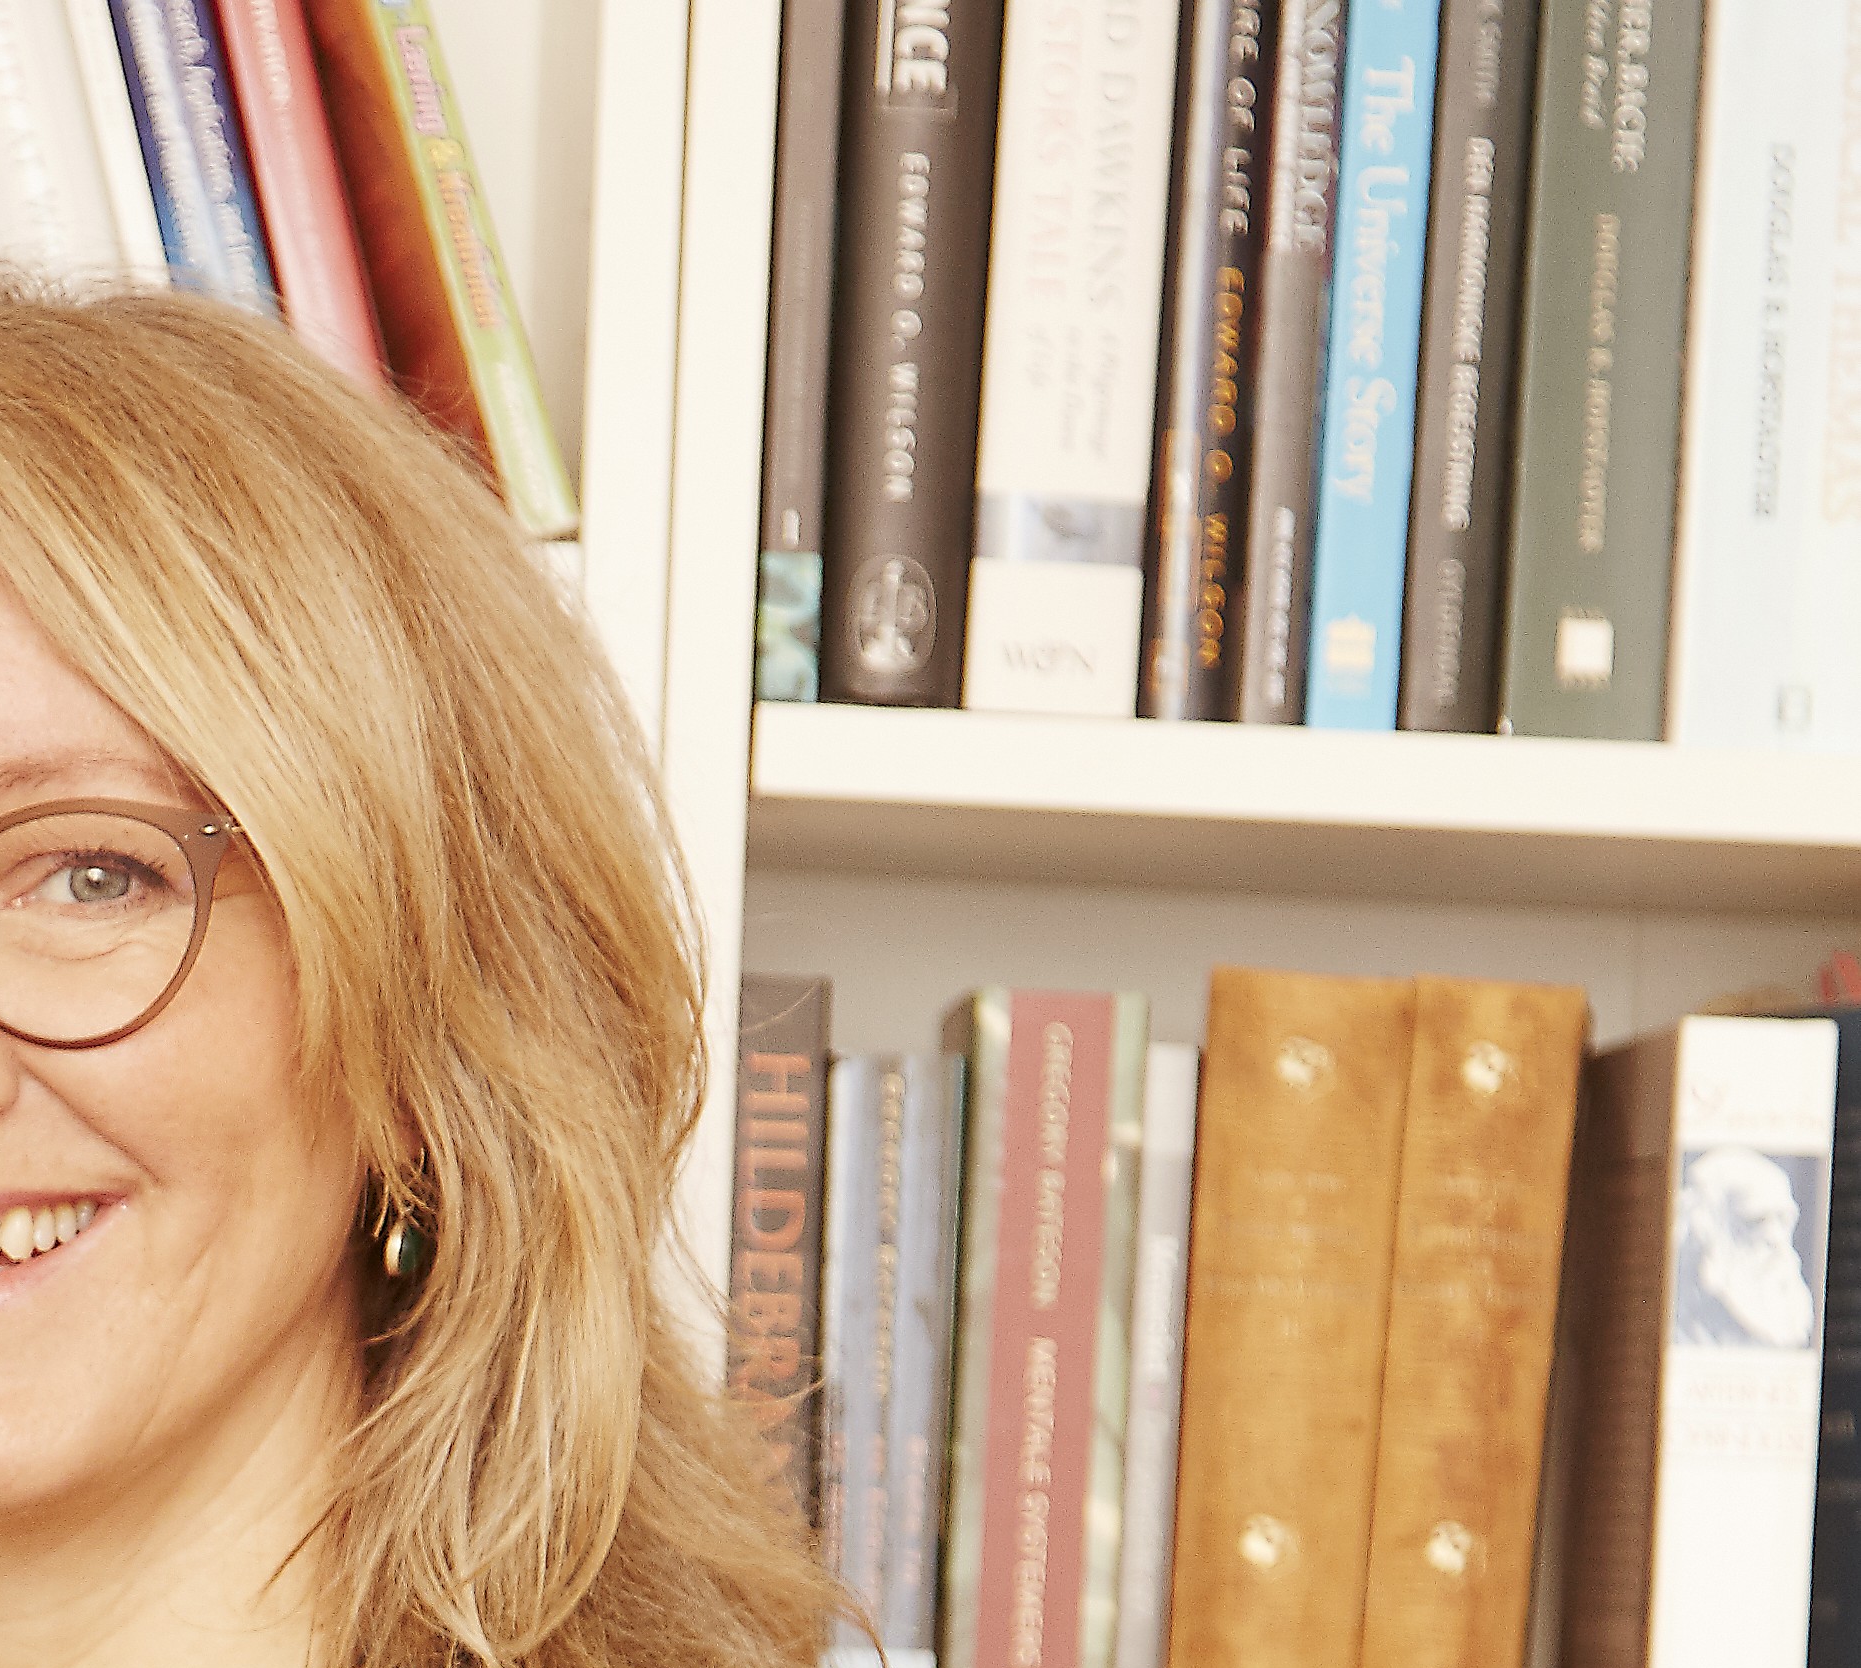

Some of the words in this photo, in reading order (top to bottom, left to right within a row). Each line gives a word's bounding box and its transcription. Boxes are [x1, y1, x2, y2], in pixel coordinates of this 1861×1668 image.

[1359, 55, 1419, 155] The
[889, 151, 931, 298] EDWARD
[1088, 70, 1142, 314] DAWKINS
[1348, 164, 1414, 370] Universe
[1205, 266, 1247, 438] EDWARD
[881, 361, 921, 505] WILSON
[1330, 376, 1399, 506] Story
[1195, 512, 1231, 671] WILSON
[1038, 1021, 1075, 1162] GREGORY
[1030, 1168, 1070, 1311] BATESON
[1019, 1336, 1060, 1485] MENTALE
[1009, 1490, 1050, 1668] SYSTEMERS
